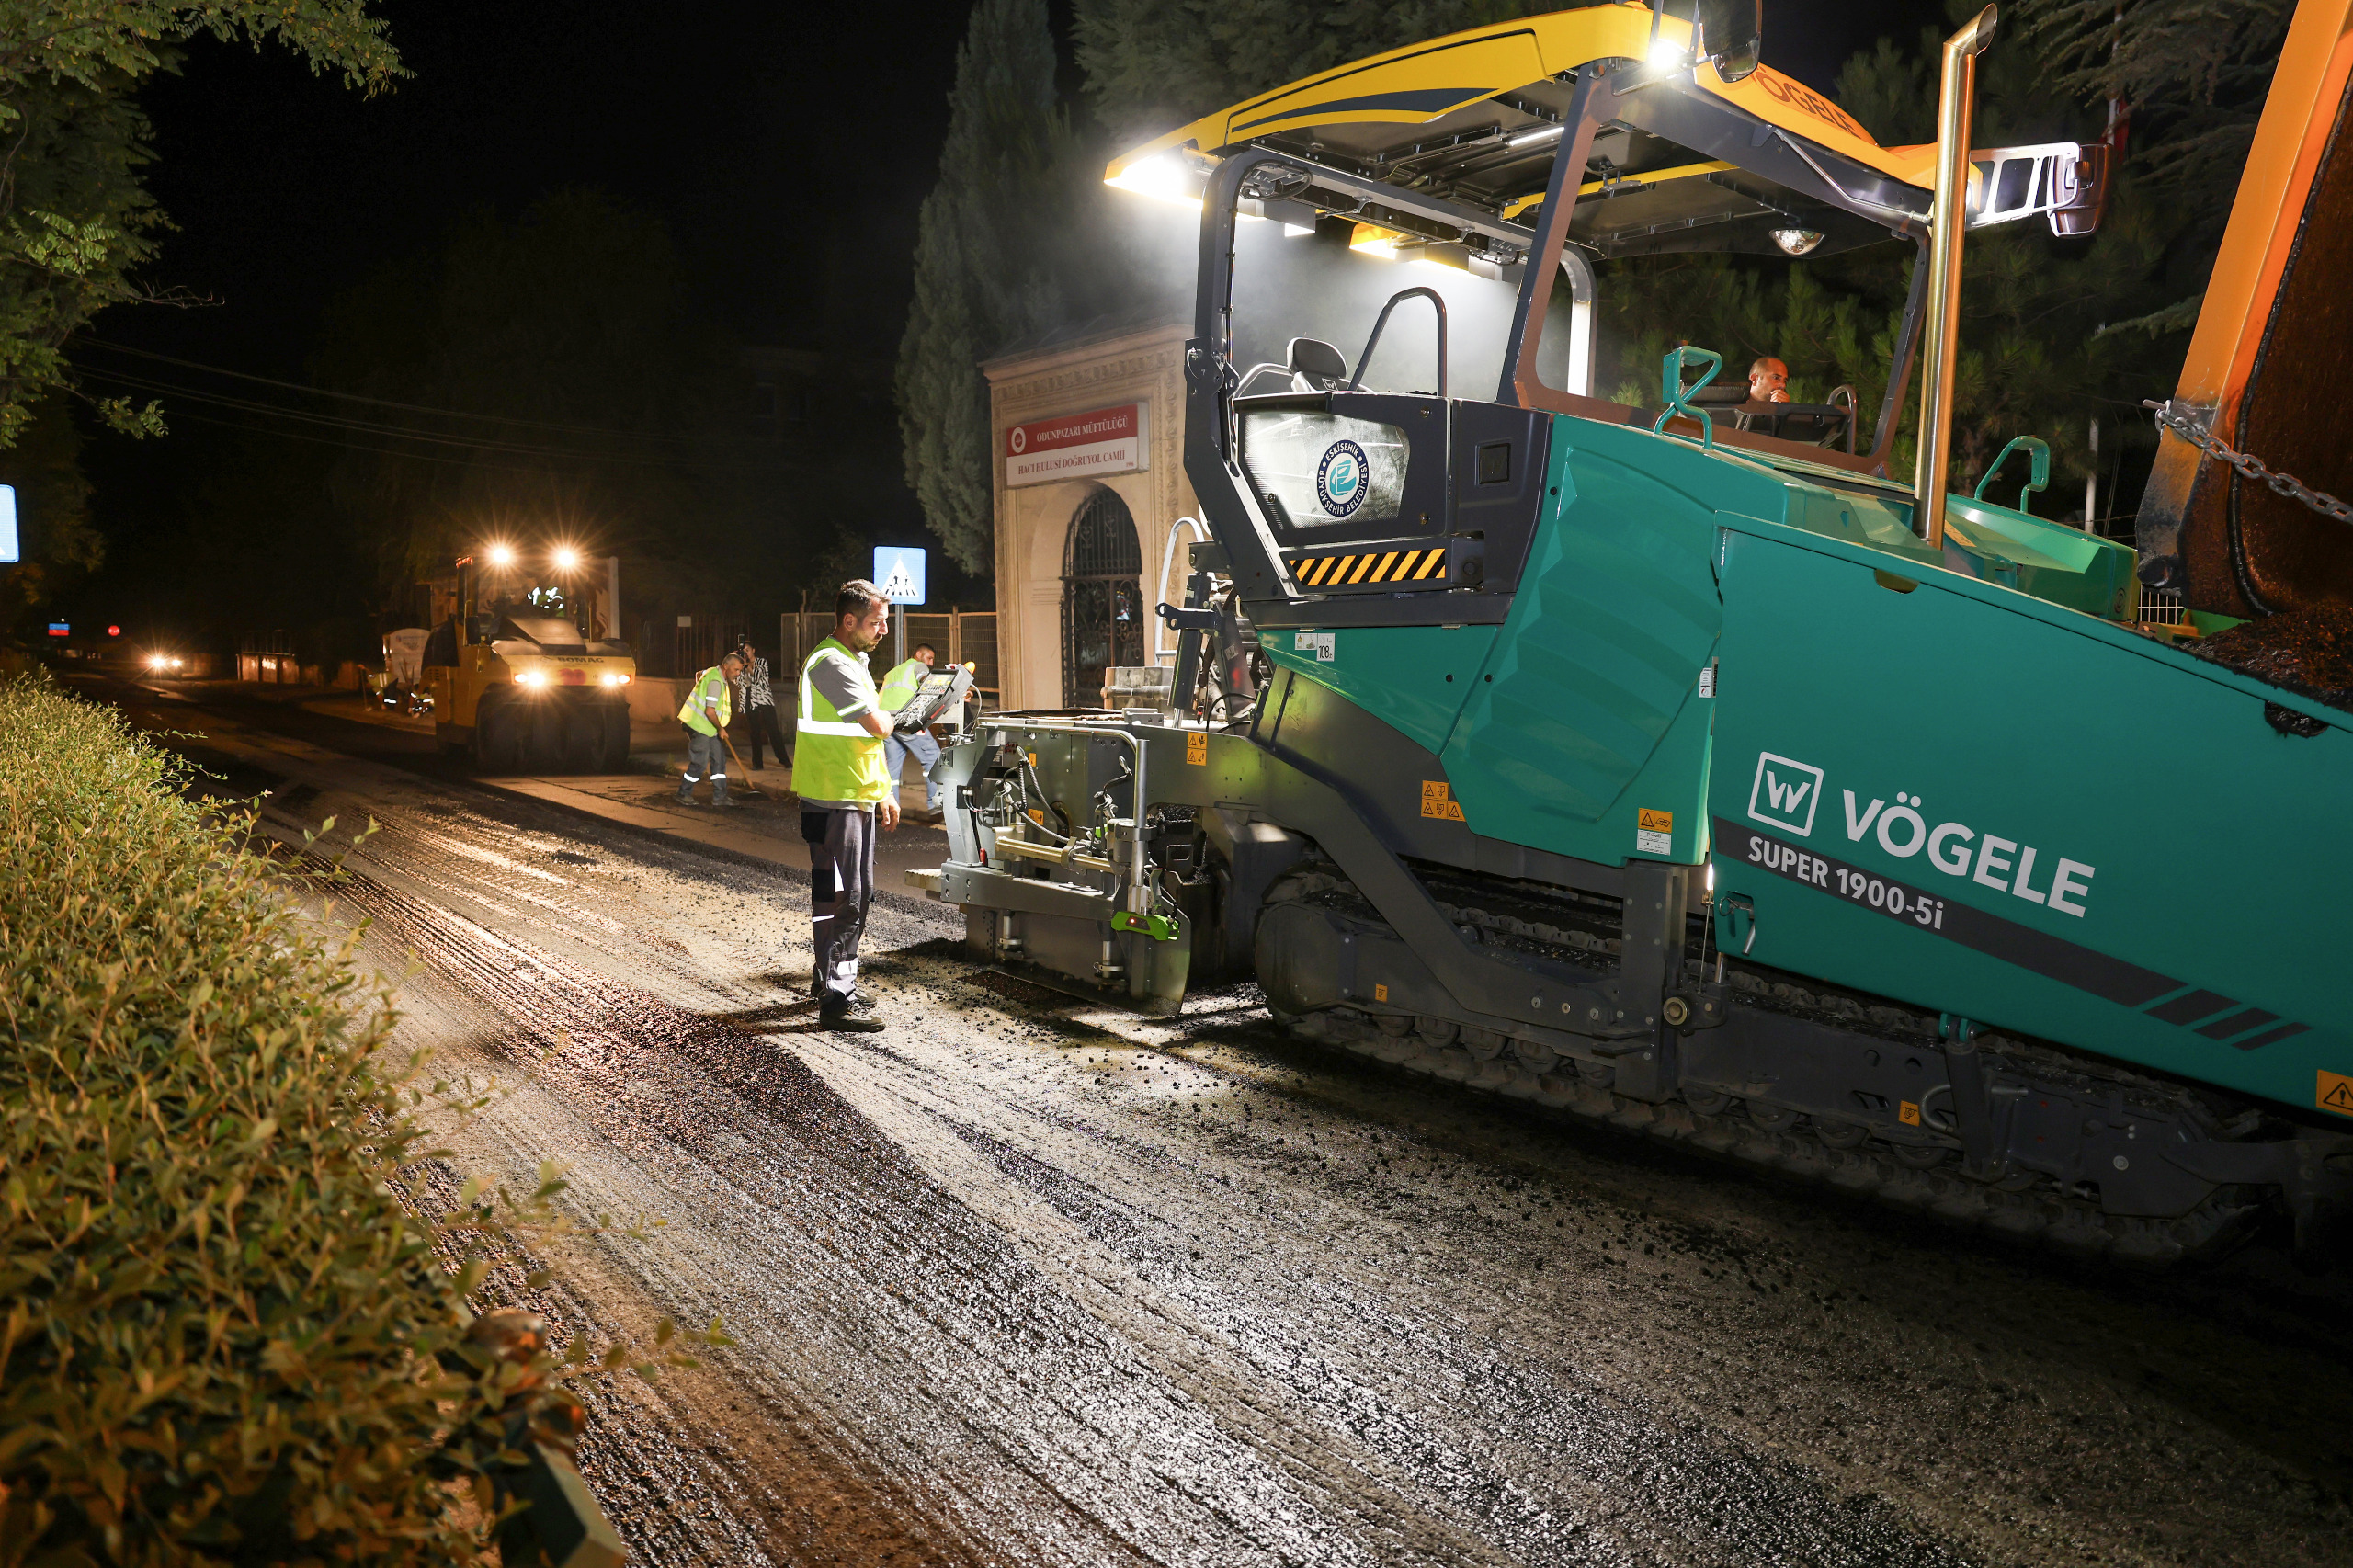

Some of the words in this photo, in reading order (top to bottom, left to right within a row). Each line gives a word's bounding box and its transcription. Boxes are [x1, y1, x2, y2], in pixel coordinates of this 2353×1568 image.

[1750, 65, 1861, 140] ÖGELE
[1037, 426, 1081, 443] ODUNPAZARI
[1082, 415, 1129, 435] MÜFTÜLÜĞÜ
[1018, 463, 1035, 475] HACI
[1036, 457, 1062, 472] HULUSİ
[1063, 453, 1102, 468] DOĞRUYOL
[1103, 448, 1125, 462] CAMİİ
[1325, 442, 1359, 461] ESKİŞEHİR
[1318, 470, 1345, 515] BÜYÜKŞEHİR
[1346, 462, 1368, 513] BELEDİYESİ
[1318, 645, 1330, 659] 108
[1842, 788, 2096, 918] VÖGELE
[1747, 835, 1828, 888] SUPER
[1836, 868, 1944, 930] 1900-5i
